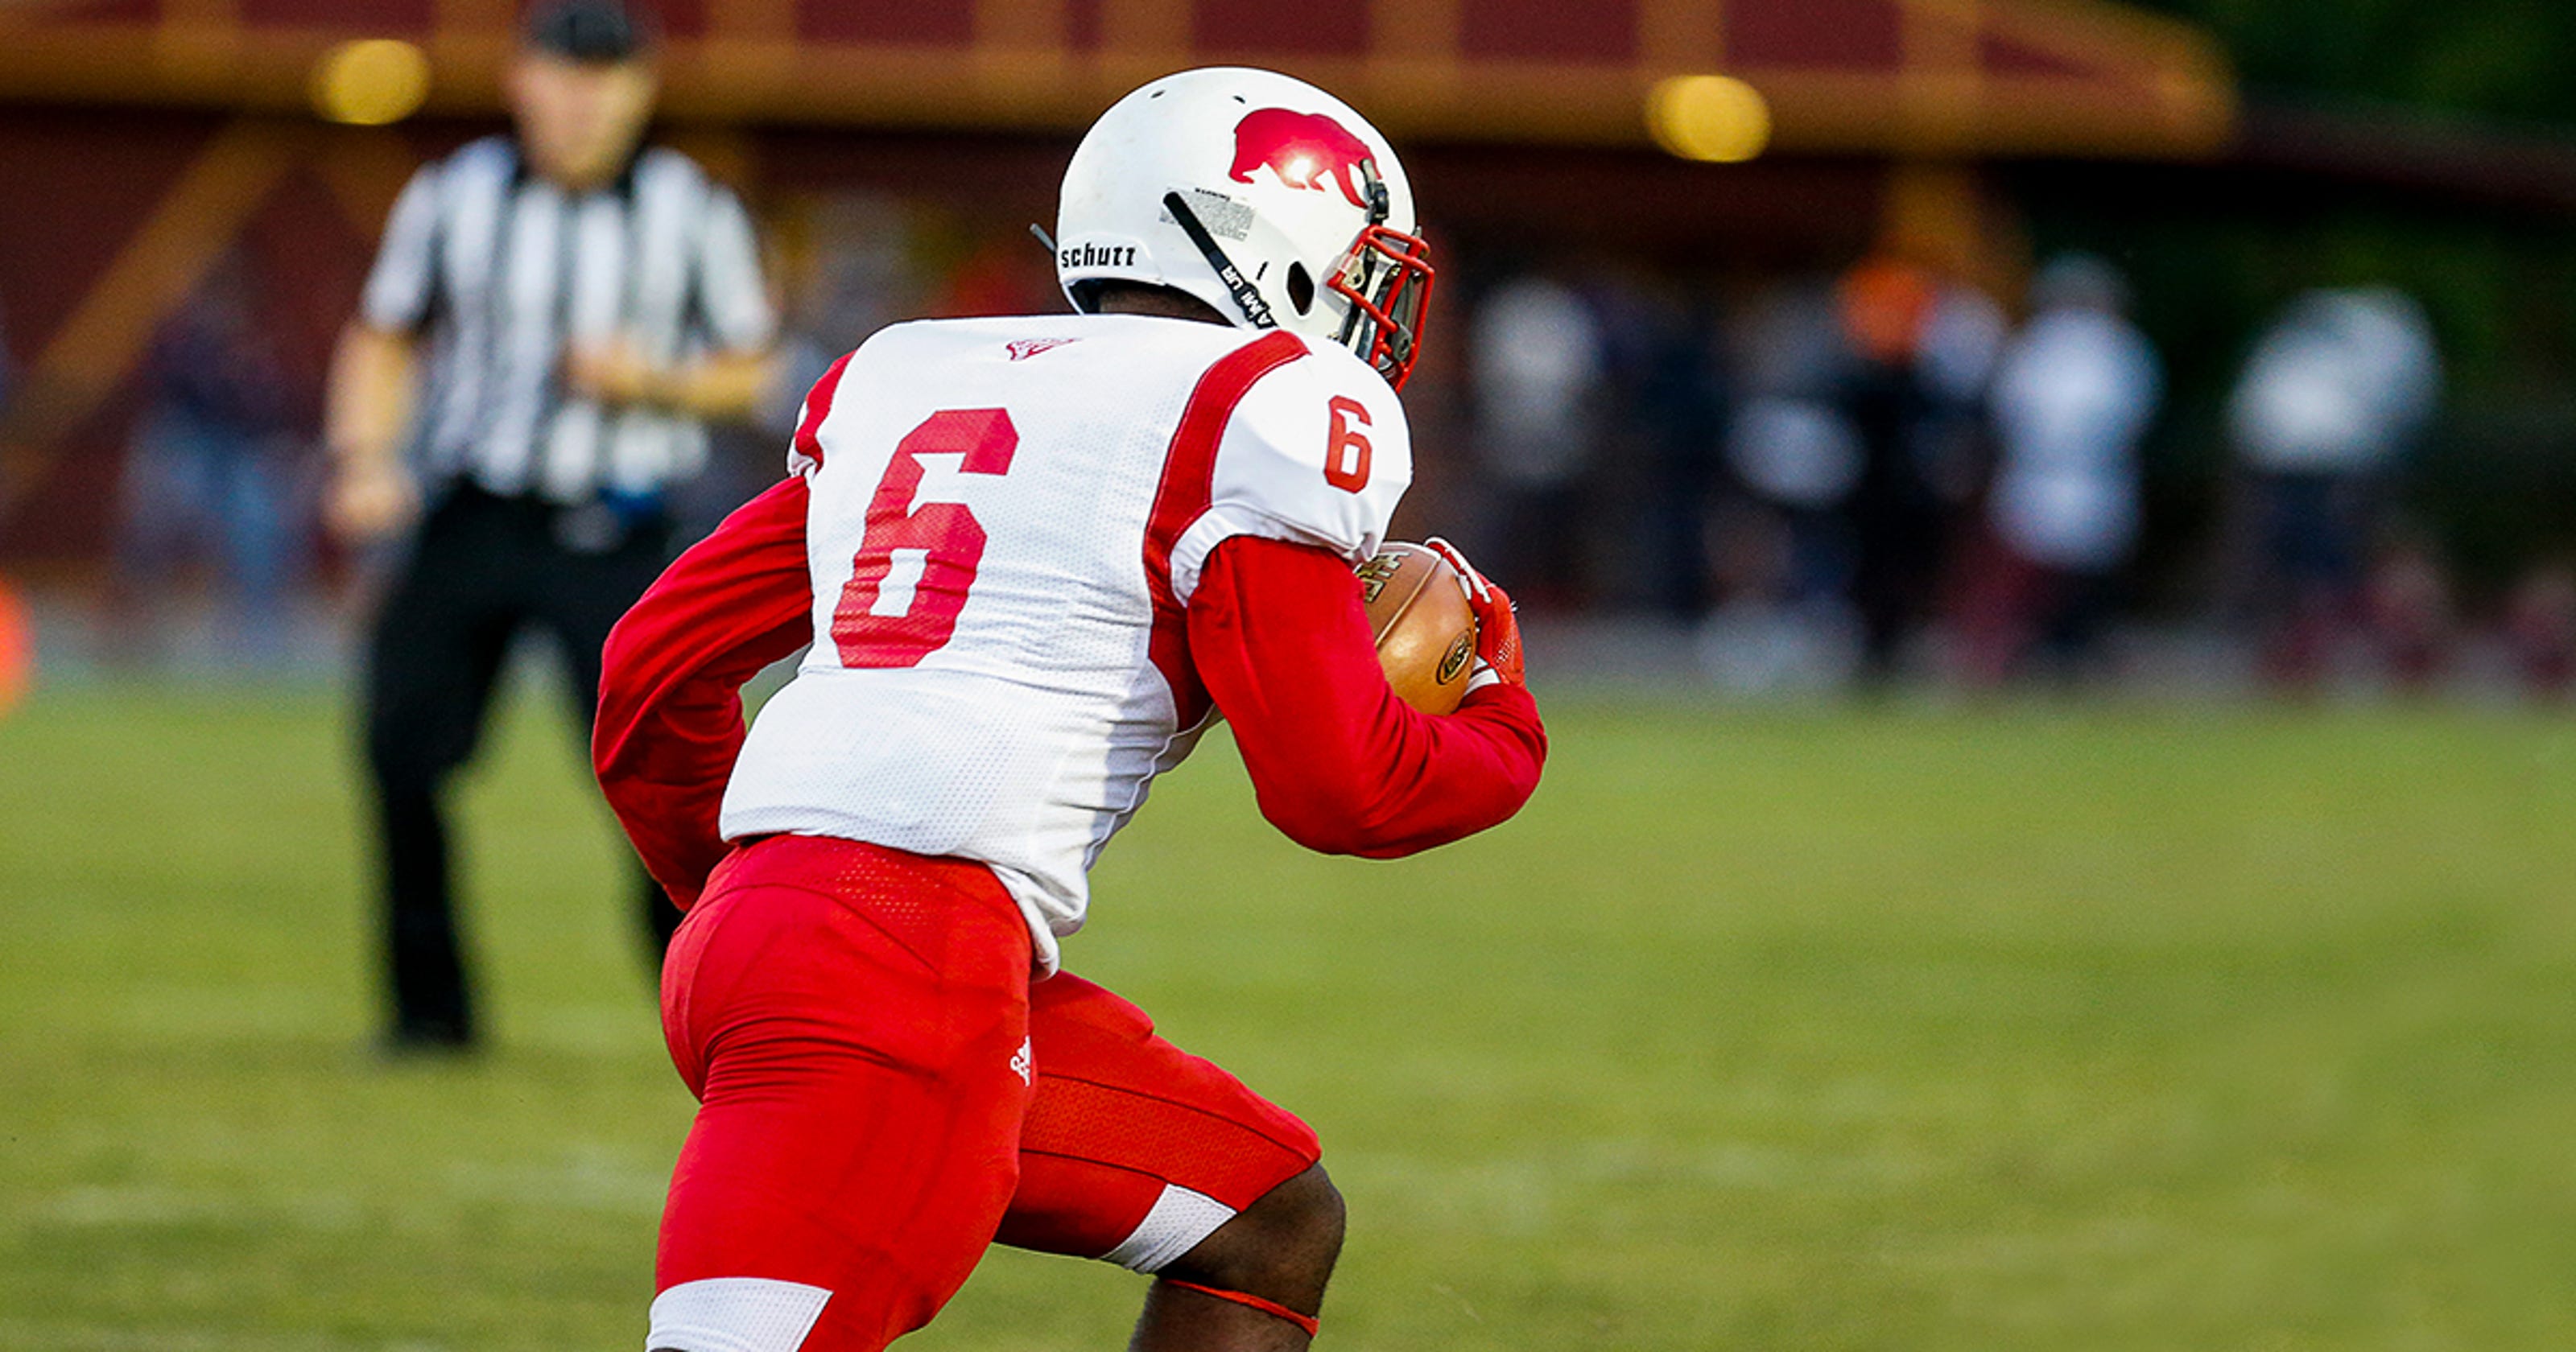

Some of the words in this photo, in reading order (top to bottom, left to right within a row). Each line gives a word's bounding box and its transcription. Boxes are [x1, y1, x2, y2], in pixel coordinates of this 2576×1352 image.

[1061, 242, 1136, 268] schutt
[1323, 394, 1373, 494] 6
[831, 407, 1019, 668] 6
